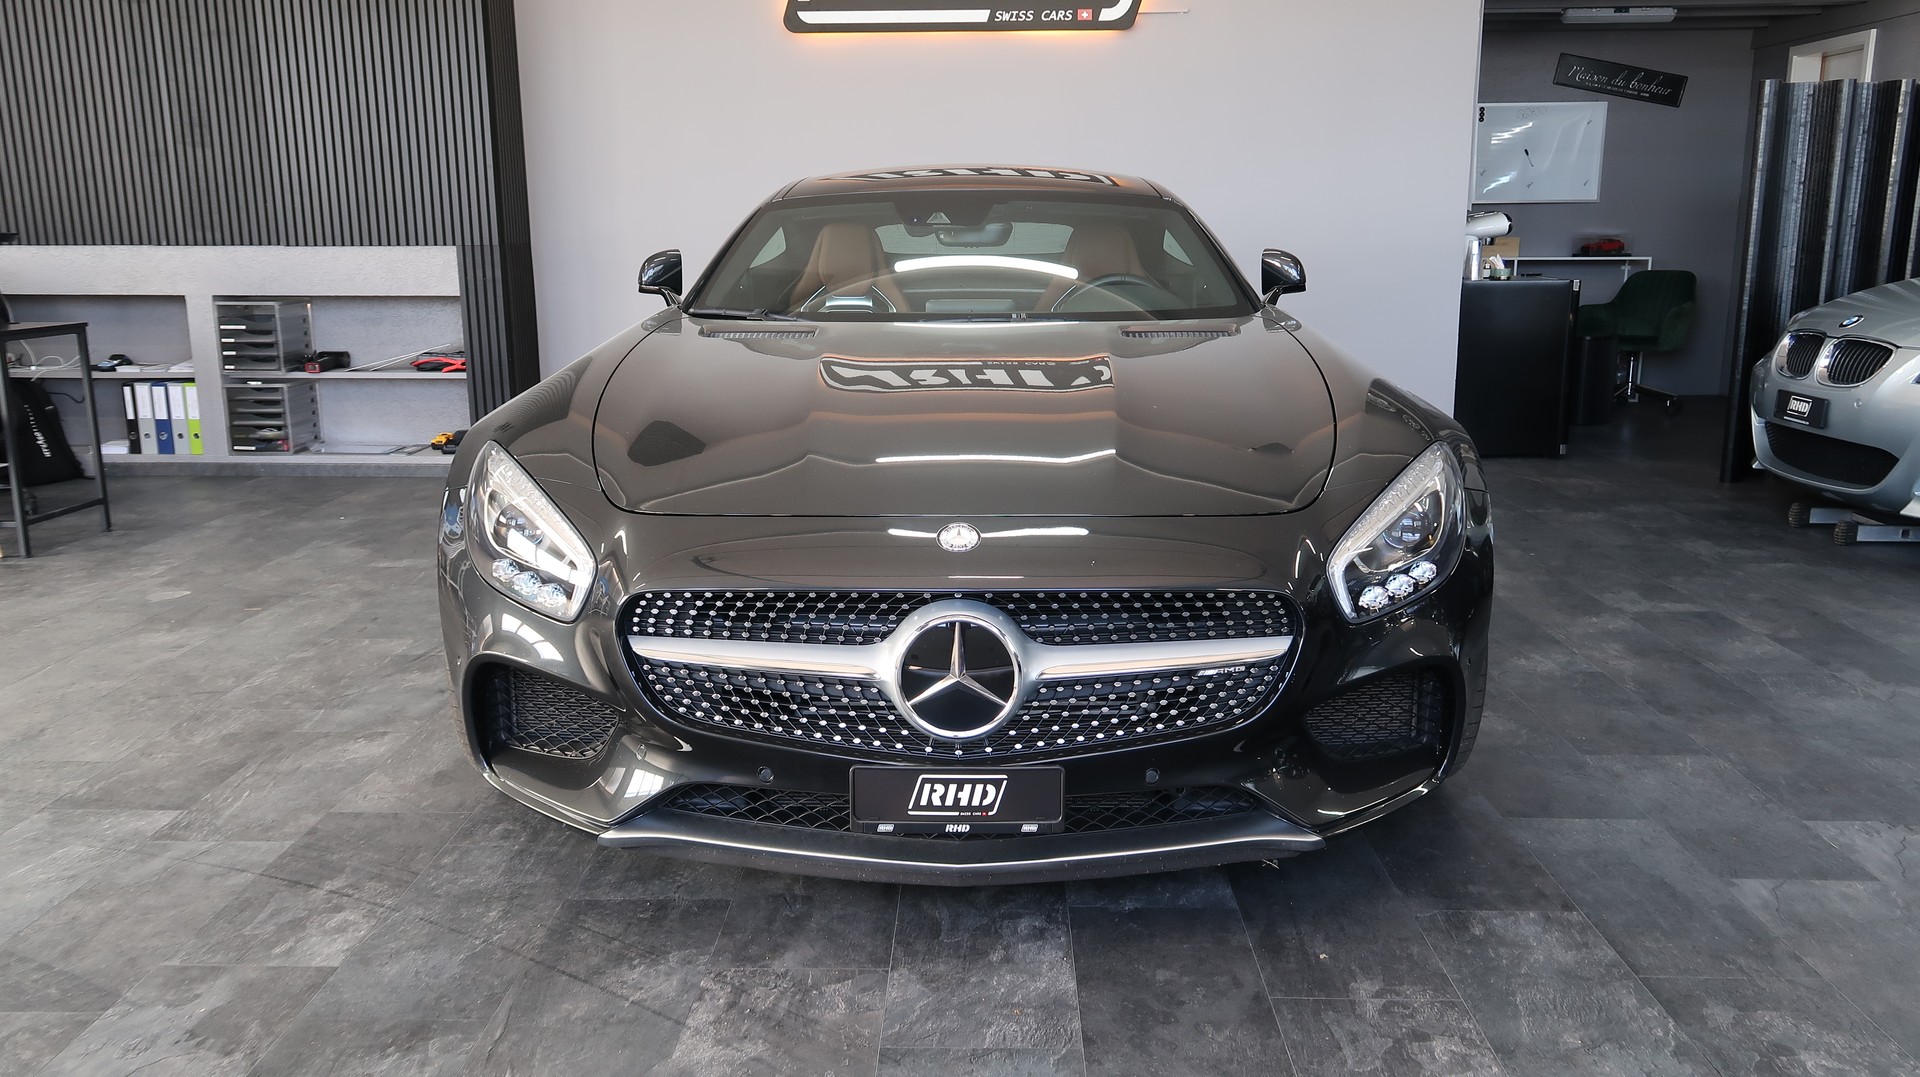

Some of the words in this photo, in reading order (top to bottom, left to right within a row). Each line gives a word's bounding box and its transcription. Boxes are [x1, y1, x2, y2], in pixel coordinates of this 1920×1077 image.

[994, 10, 1034, 22] SWISS
[1041, 9, 1073, 21] CARS
[1567, 66, 1608, 82] Maison
[1611, 69, 1627, 87] du
[1629, 71, 1672, 95] bonheur
[1790, 399, 1809, 412] RHD
[920, 783, 996, 806] RHD
[945, 824, 970, 833] RHD
